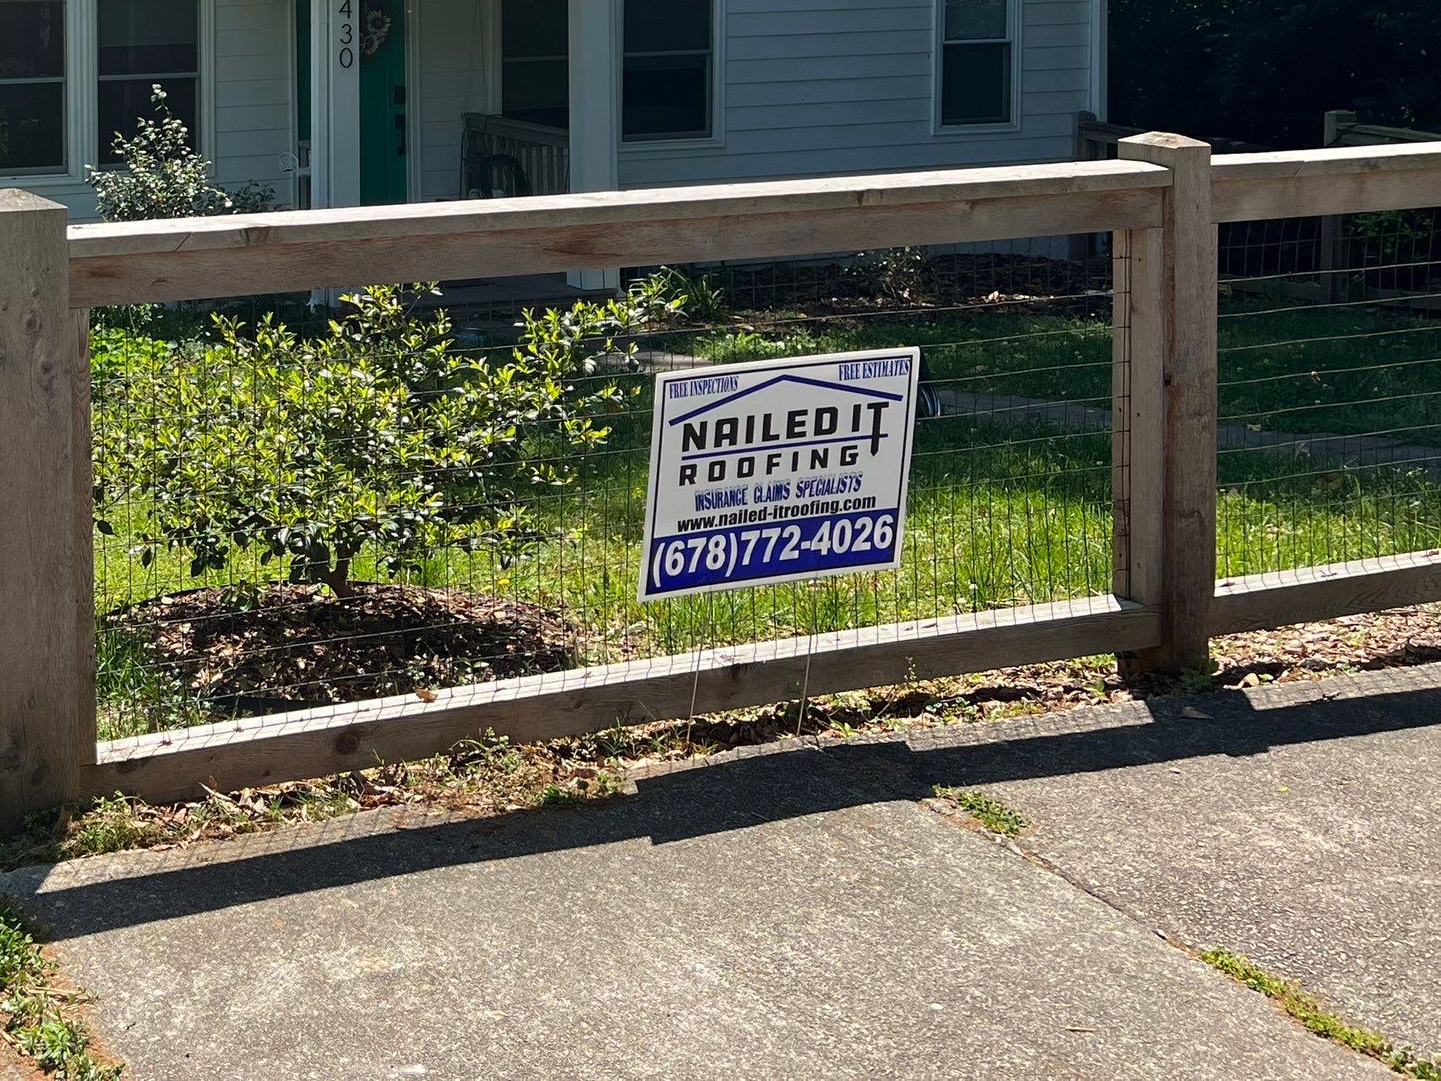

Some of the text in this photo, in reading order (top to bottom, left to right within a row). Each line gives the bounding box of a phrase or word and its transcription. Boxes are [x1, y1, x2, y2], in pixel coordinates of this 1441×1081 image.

[669, 375, 740, 399] FREE INSPECTIONS
[839, 359, 911, 381] FREE ESTIMATES
[681, 401, 890, 457] NAILED IT
[678, 445, 859, 486] ROOFING
[695, 471, 863, 512] INSURANCE CLAIMS SPECIALISTS
[677, 496, 877, 533] www.nailed-itroofing.com
[652, 514, 894, 588] (678)772-4026
